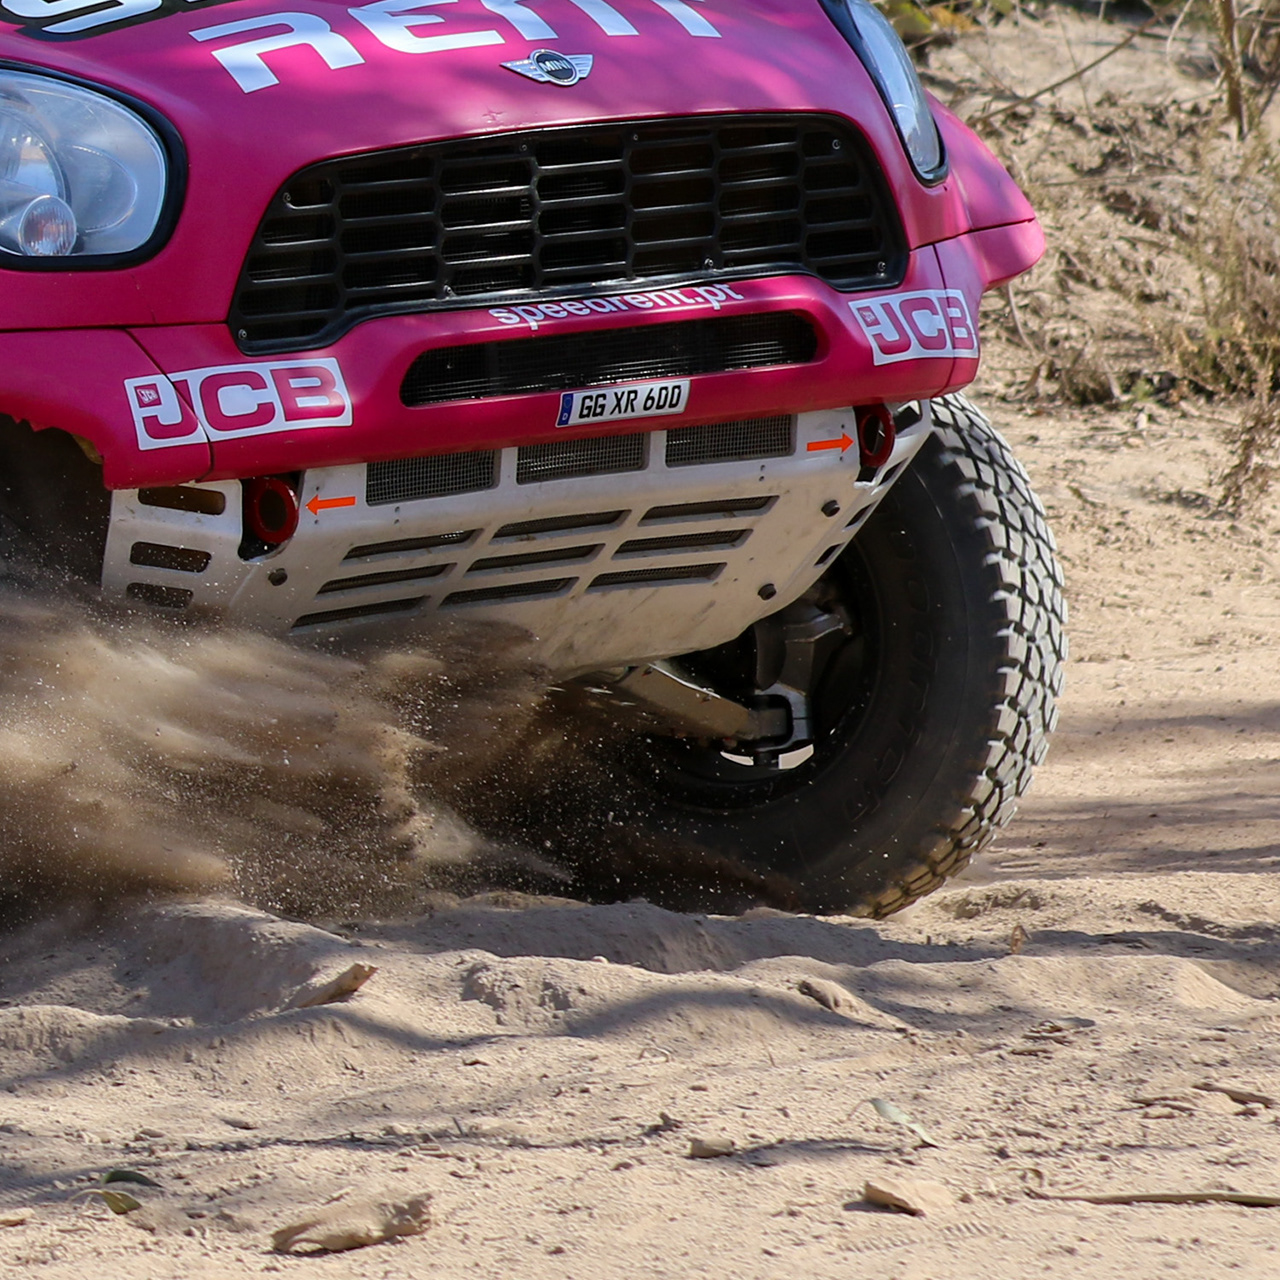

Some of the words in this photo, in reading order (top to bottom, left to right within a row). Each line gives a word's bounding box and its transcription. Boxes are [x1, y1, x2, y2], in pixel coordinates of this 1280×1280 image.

[538, 59, 572, 72] MINI
[871, 296, 975, 356] JCB
[141, 365, 347, 440] JCB
[578, 394, 607, 420] GG
[611, 390, 636, 415] XR
[642, 384, 683, 411] 600
